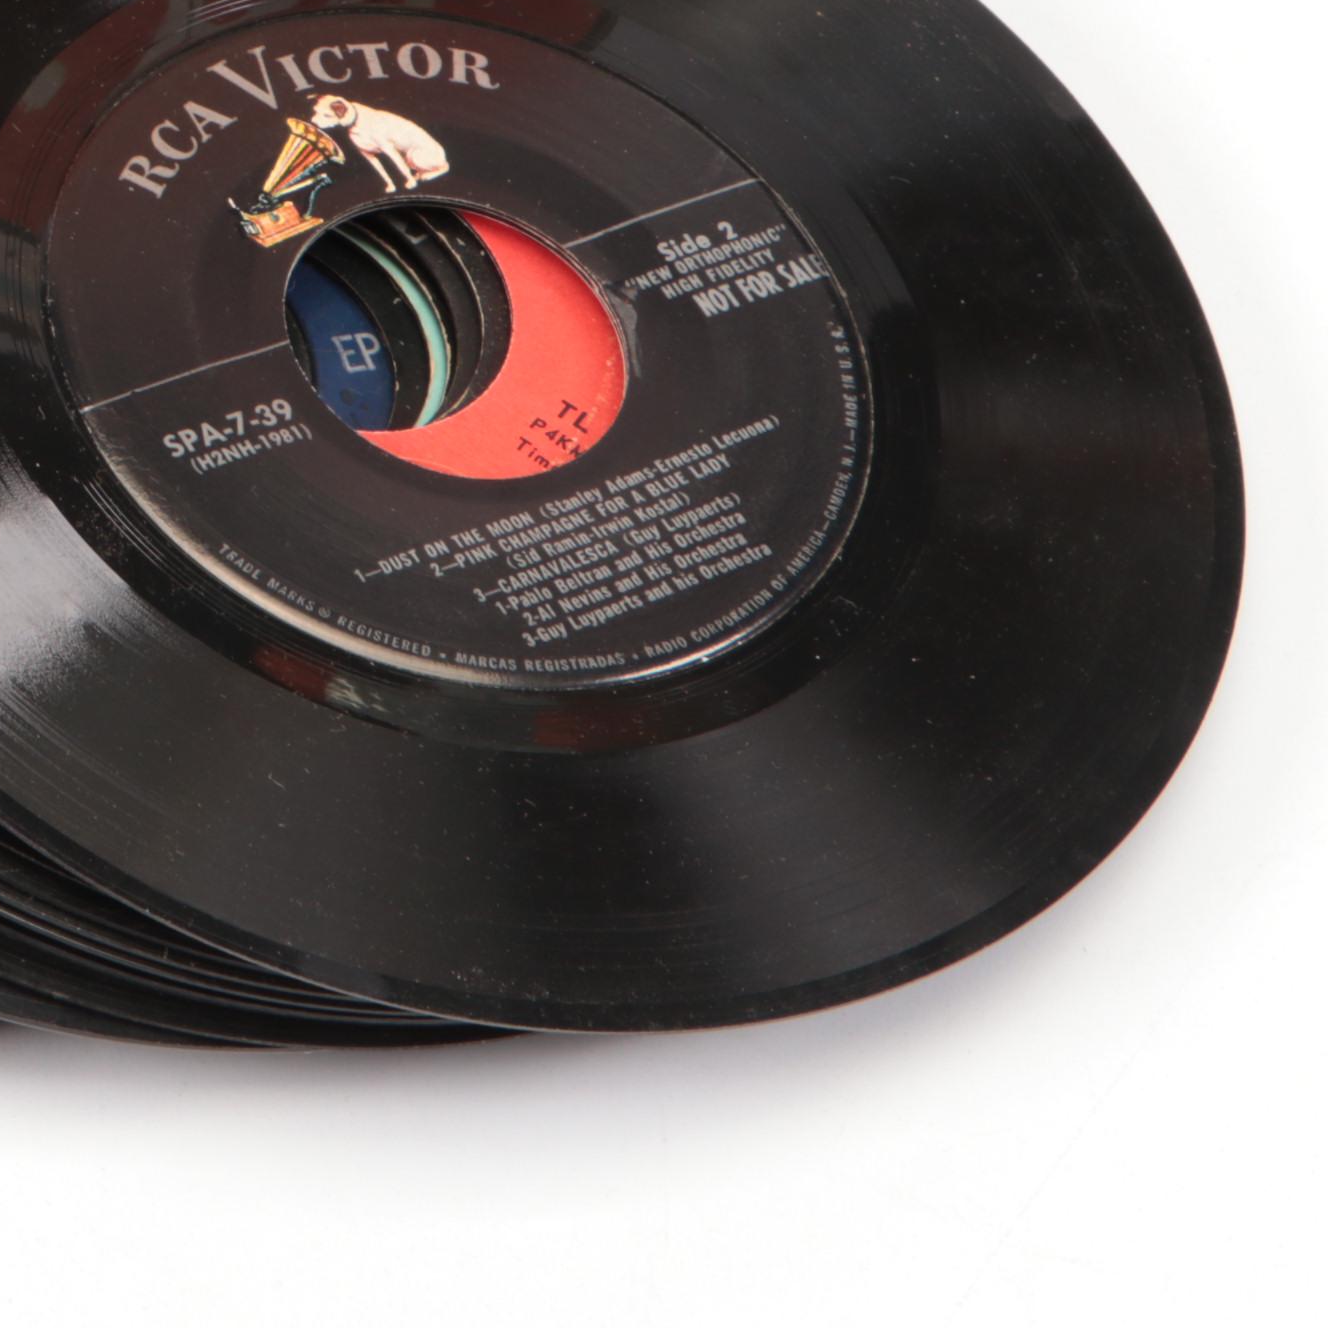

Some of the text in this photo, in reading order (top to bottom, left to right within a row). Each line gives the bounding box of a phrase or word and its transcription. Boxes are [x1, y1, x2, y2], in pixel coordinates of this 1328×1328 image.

[119, 41, 501, 199] RCA VICTOR
[657, 221, 739, 262] Side 2
[660, 248, 775, 300] HIGH FIDELITY
[692, 253, 831, 318] NOT FOR SALE
[331, 332, 382, 373] EP
[162, 399, 293, 458] SPA-7-39
[190, 423, 313, 475] (H2NH-1981)
[557, 399, 589, 434] TL
[423, 539, 451, 559] ON
[450, 528, 485, 549] THE
[486, 512, 535, 538] MOON
[539, 487, 604, 518] (Stanley
[604, 442, 713, 494] Adams-Ernesto
[711, 414, 780, 450] Lecuona)
[498, 508, 594, 553] CHAMPAGNE
[596, 495, 630, 518] FOR
[631, 489, 646, 504] A
[645, 471, 690, 498] BLUE
[687, 453, 732, 480] LADY
[622, 524, 662, 547] (Guy
[661, 491, 741, 533] Luypaerts)
[495, 511, 747, 616] 1-Pablo Beltran and His Orchestra
[506, 491, 691, 570] (Sid Ramin-Irwin Kostal)
[218, 543, 261, 580] TRADE
[266, 577, 316, 612] MARKS
[337, 615, 432, 657] REGISTERED
[455, 651, 517, 671] MARCAS
[524, 651, 626, 672] REGISTRADAS
[643, 635, 688, 659] RADIO
[690, 588, 774, 643] CORPORATION
[770, 574, 789, 592] OF
[522, 532, 748, 627] 2-Al Nevins and His Orchestra
[522, 543, 773, 648] 3-Guy Luypaerts and his Orchestra
